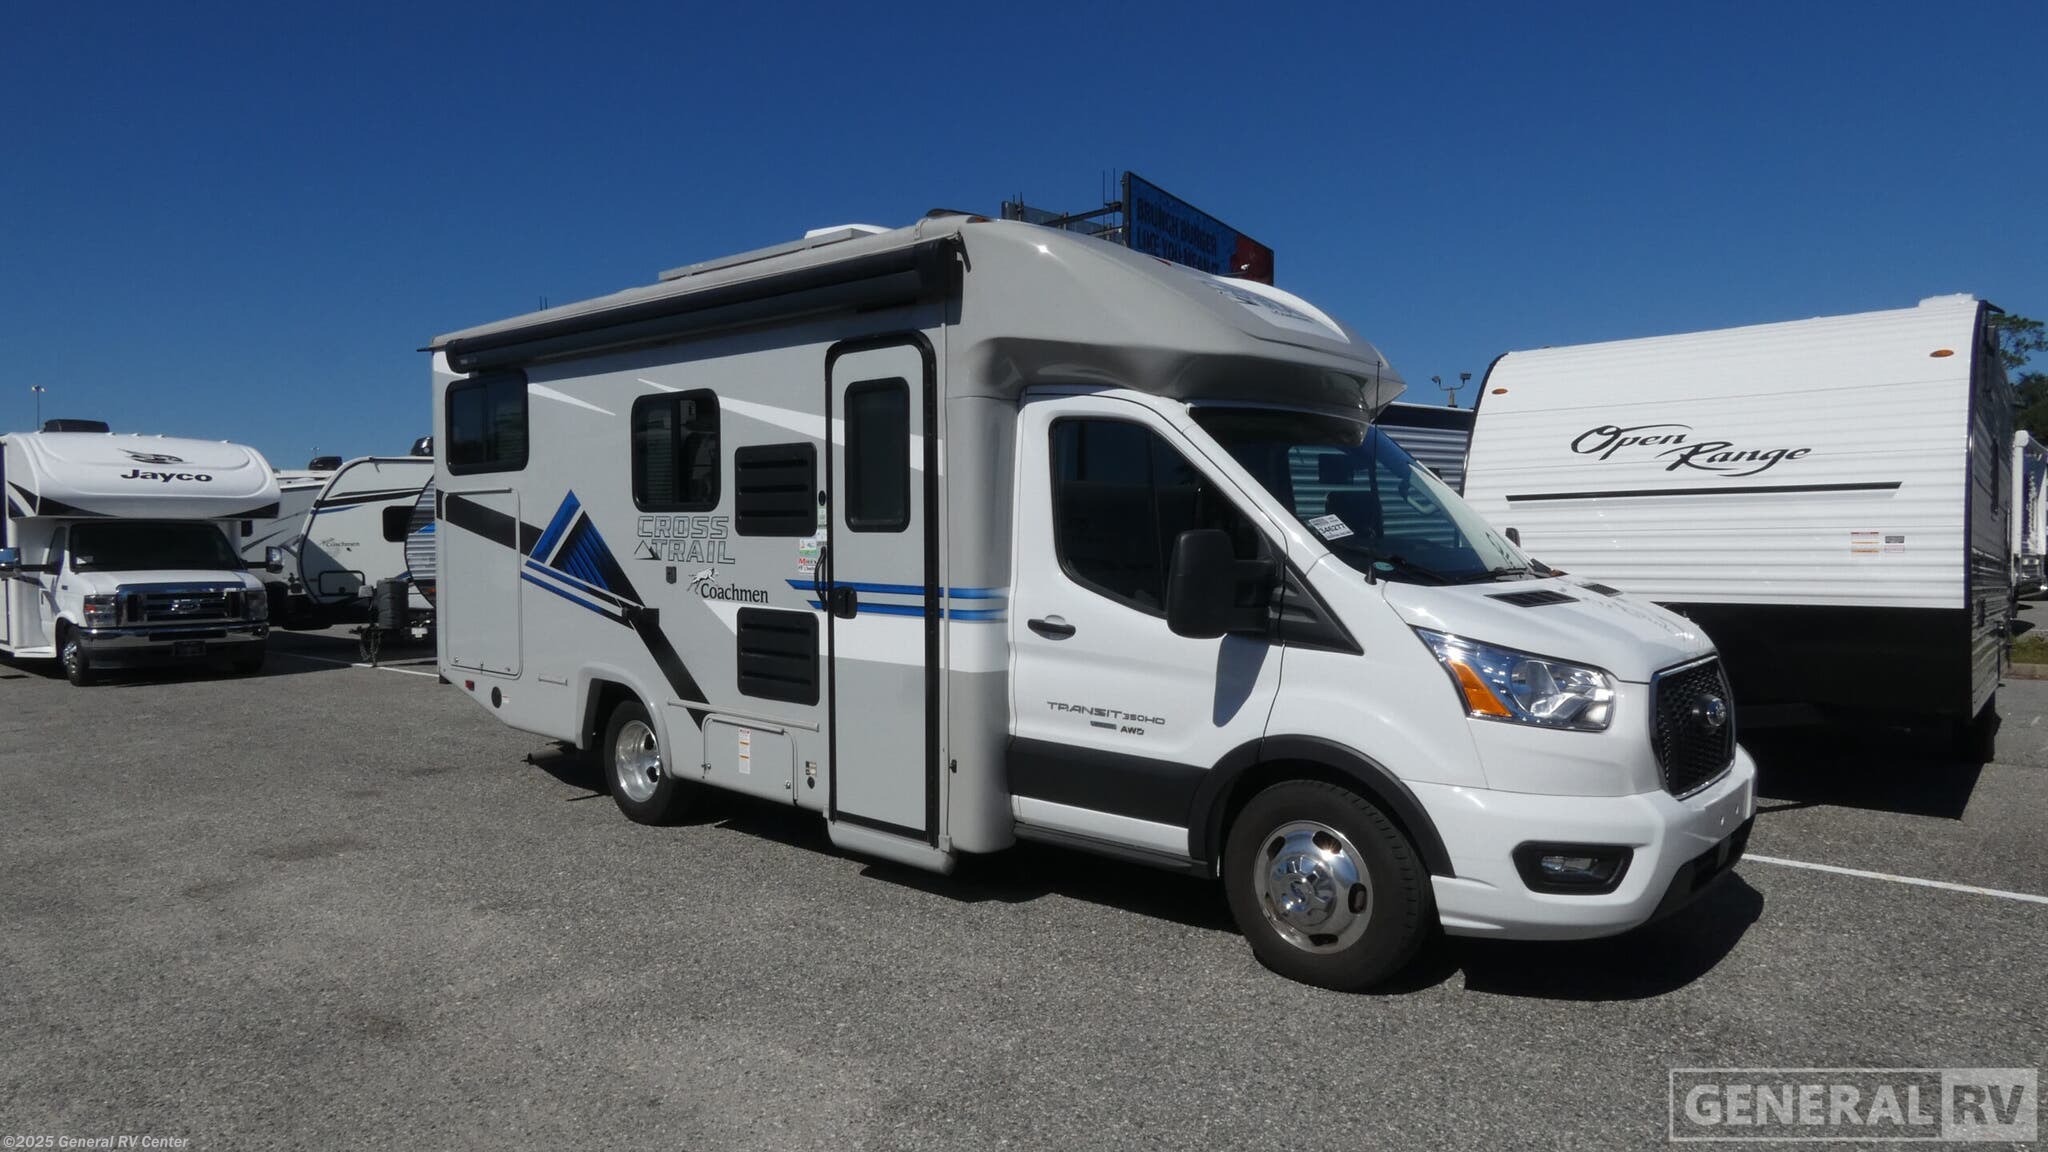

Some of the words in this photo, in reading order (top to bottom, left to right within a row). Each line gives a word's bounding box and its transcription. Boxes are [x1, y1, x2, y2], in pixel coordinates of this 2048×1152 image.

[1571, 424, 1693, 461] Open
[1655, 441, 1812, 477] Range
[120, 469, 213, 483] Jayco
[637, 515, 729, 540] CROSS
[651, 538, 736, 565] TRAIL
[700, 583, 769, 604] Coachmen
[1120, 726, 1145, 736] AWD
